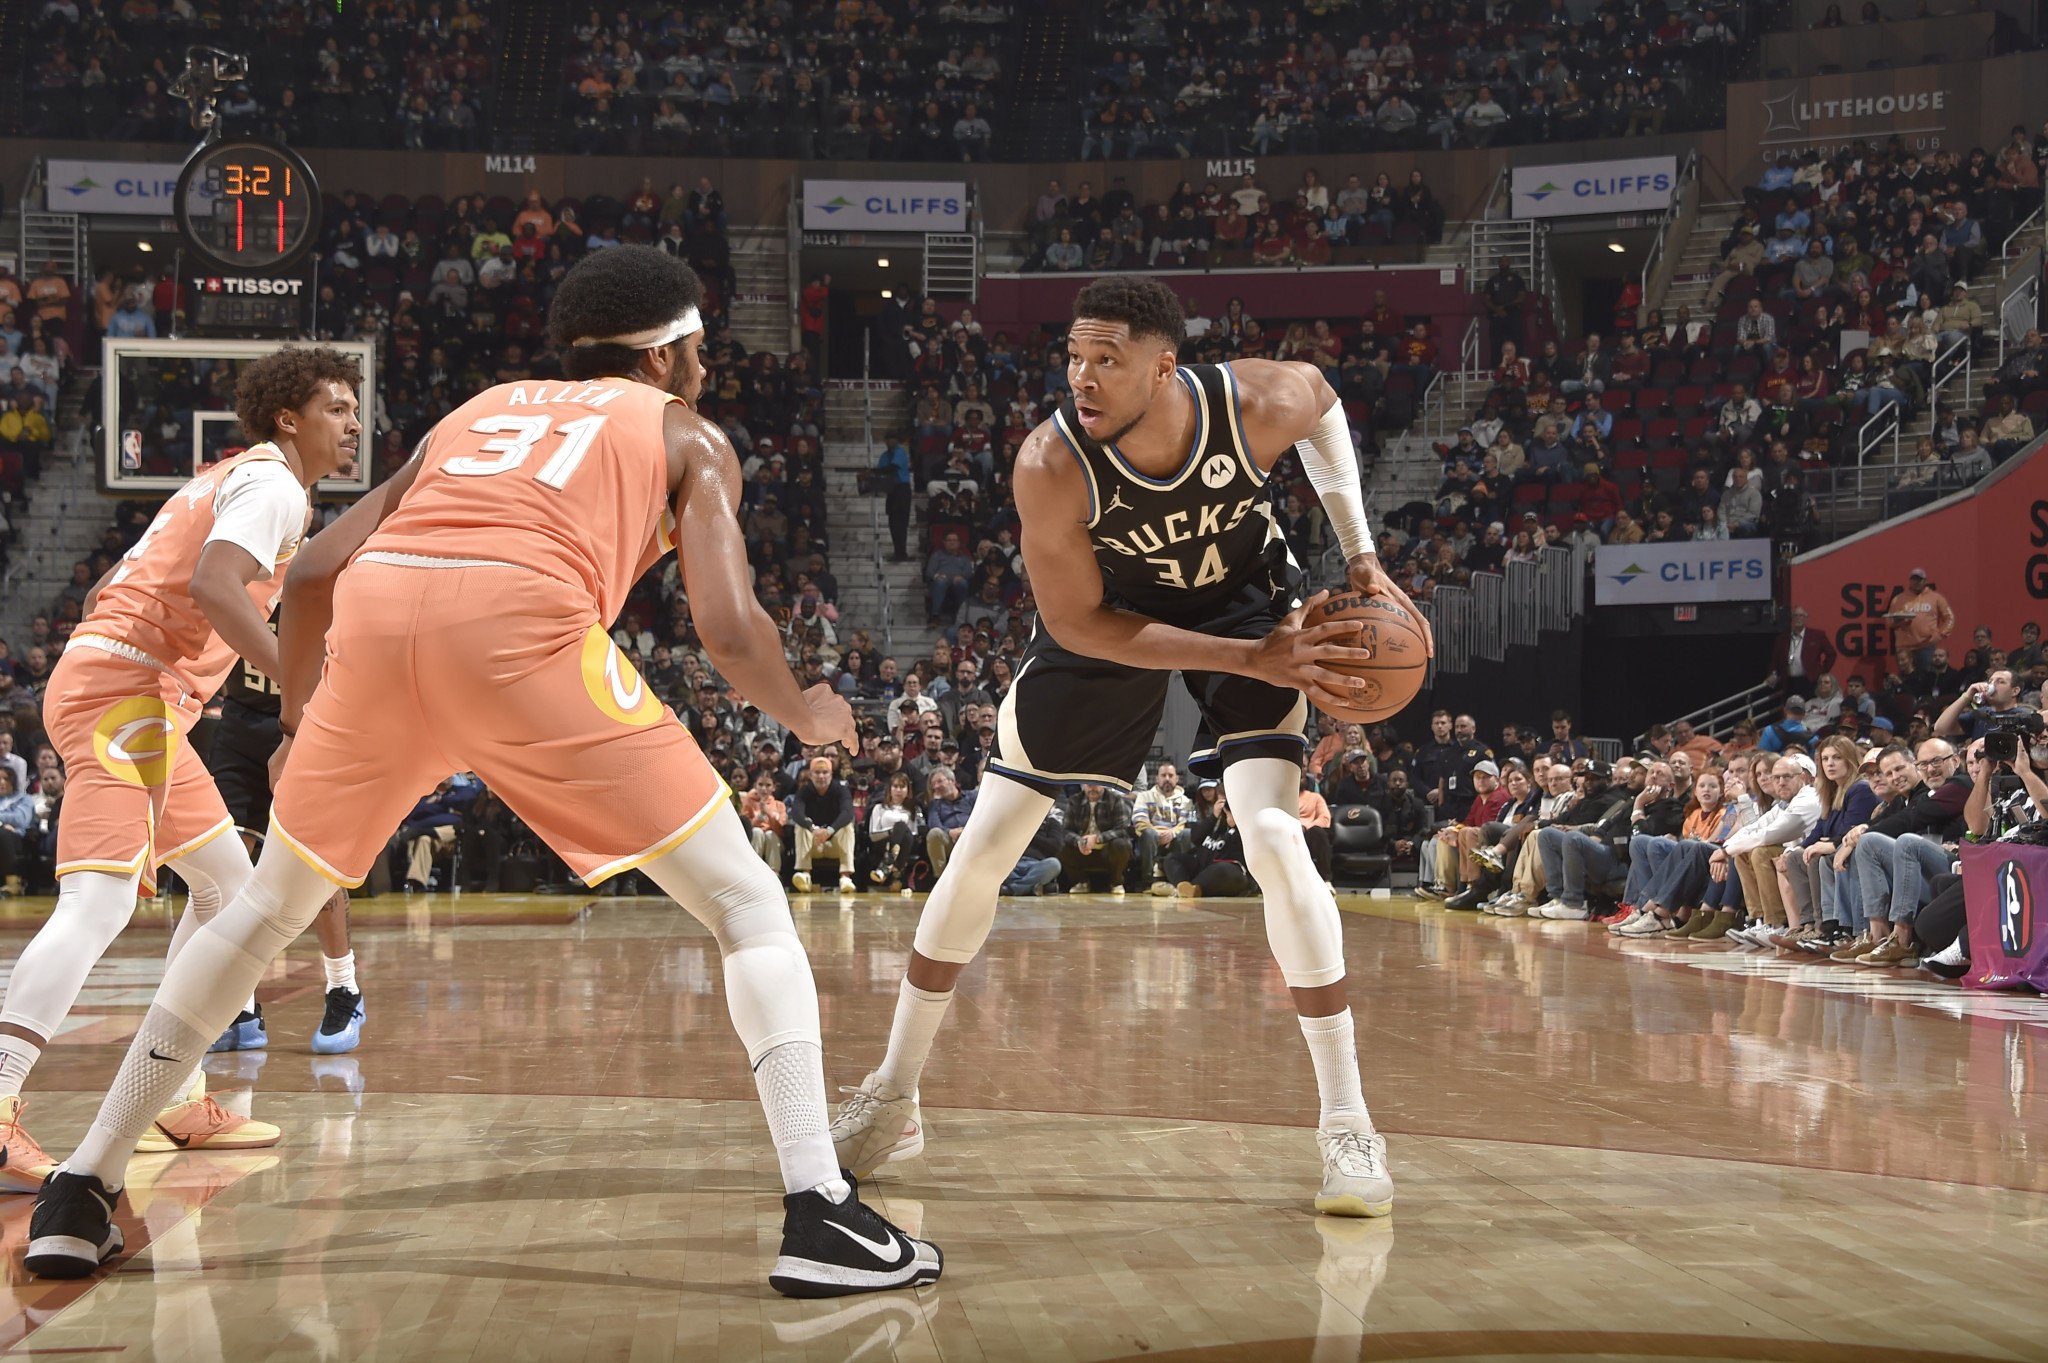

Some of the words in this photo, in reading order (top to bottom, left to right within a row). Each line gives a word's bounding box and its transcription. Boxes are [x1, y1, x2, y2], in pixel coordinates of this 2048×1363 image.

[1800, 91, 1944, 121] LITEHOUSE
[485, 155, 537, 173] M114
[1206, 159, 1256, 177] M115
[225, 164, 291, 197] 3:21
[1573, 174, 1670, 197] CLIFFS
[865, 197, 960, 215] CLIFFS
[224, 278, 303, 295] TISSOT
[508, 385, 626, 407] ALLEN
[438, 413, 609, 493] 31
[1097, 495, 1257, 557] BUCKS
[1145, 542, 1229, 590] 34
[1660, 559, 1763, 582] CLIFFS
